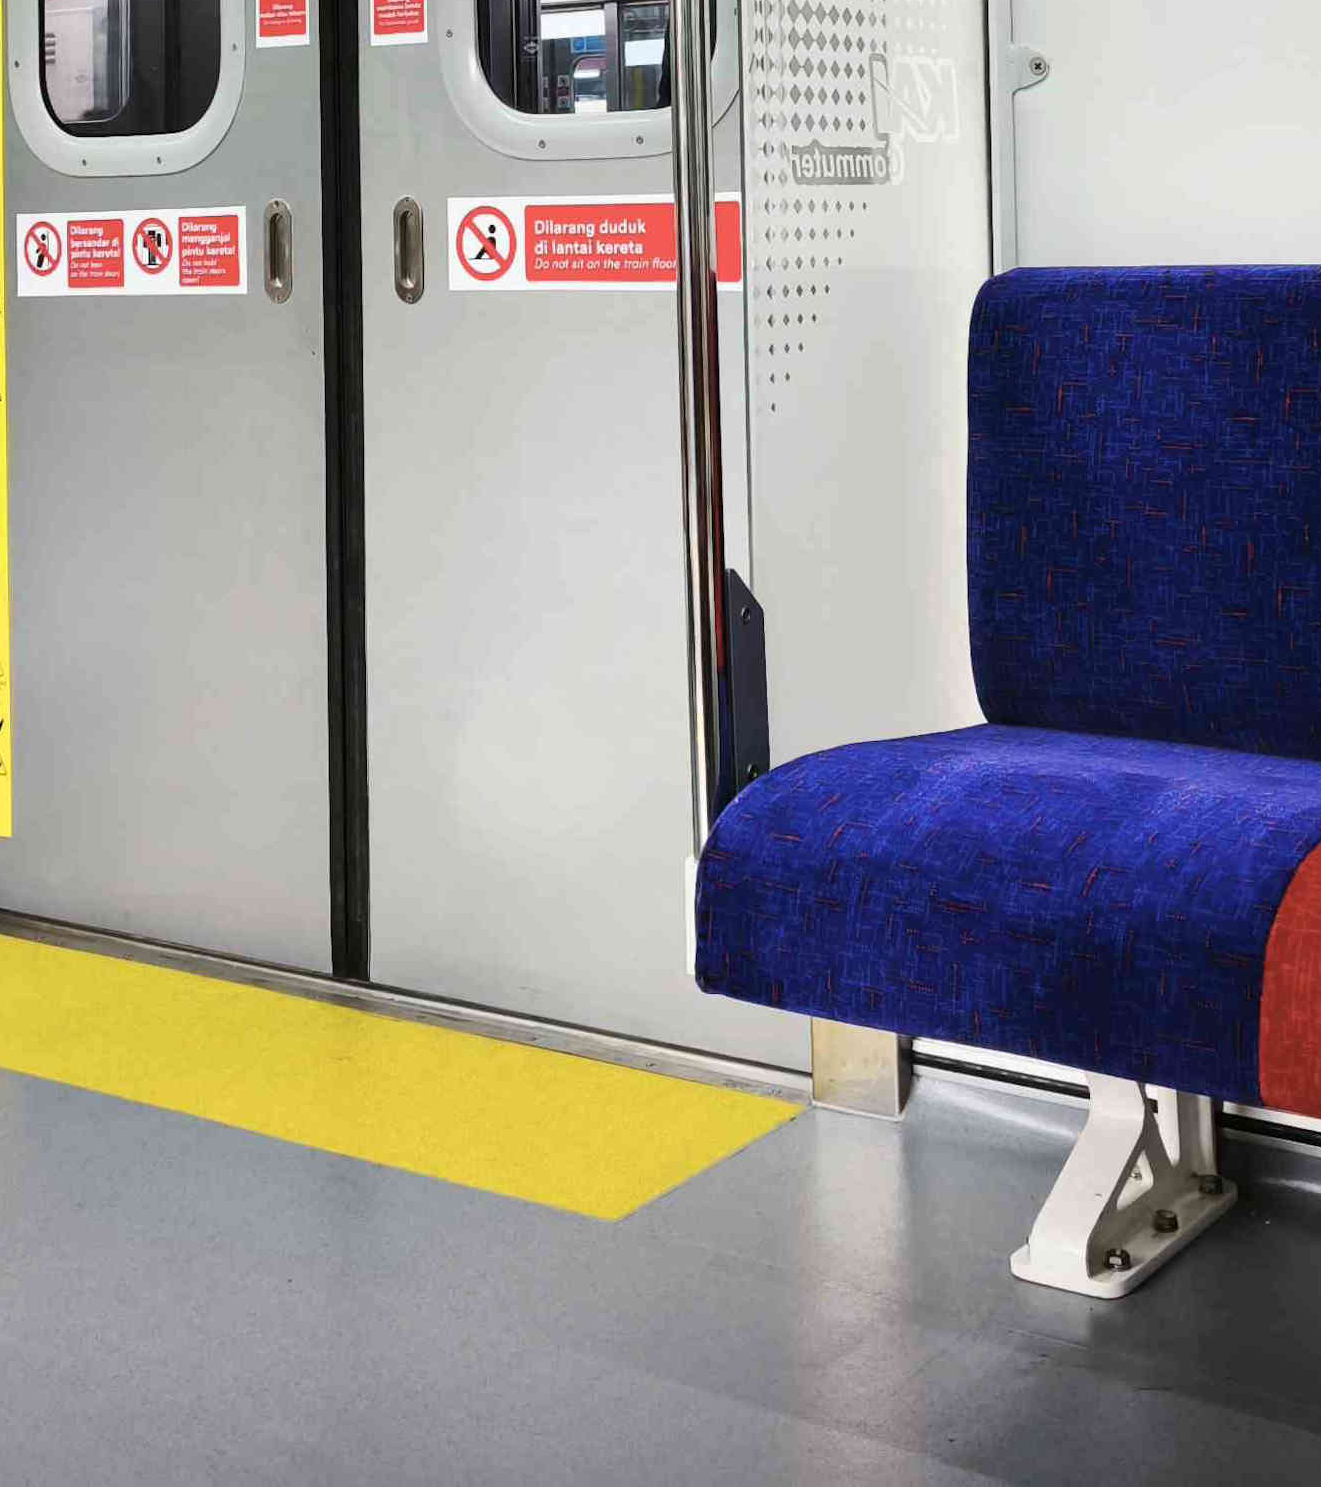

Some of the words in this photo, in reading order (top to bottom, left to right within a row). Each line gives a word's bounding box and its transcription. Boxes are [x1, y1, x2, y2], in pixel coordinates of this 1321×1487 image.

[71, 225, 104, 237] Dilarang
[181, 221, 217, 234] Dilarang
[534, 219, 595, 238] Dilarang
[599, 218, 646, 235] duduk
[71, 239, 109, 249] bersandar
[534, 241, 548, 256] di
[551, 239, 592, 256] lantai
[595, 239, 644, 256] kereta
[71, 250, 91, 261] pintu
[181, 246, 205, 258] pintu
[534, 259, 550, 270] Do
[551, 259, 569, 270] not
[571, 259, 585, 270] sit
[587, 261, 601, 270] on
[602, 258, 621, 270] the
[623, 257, 650, 269] train
